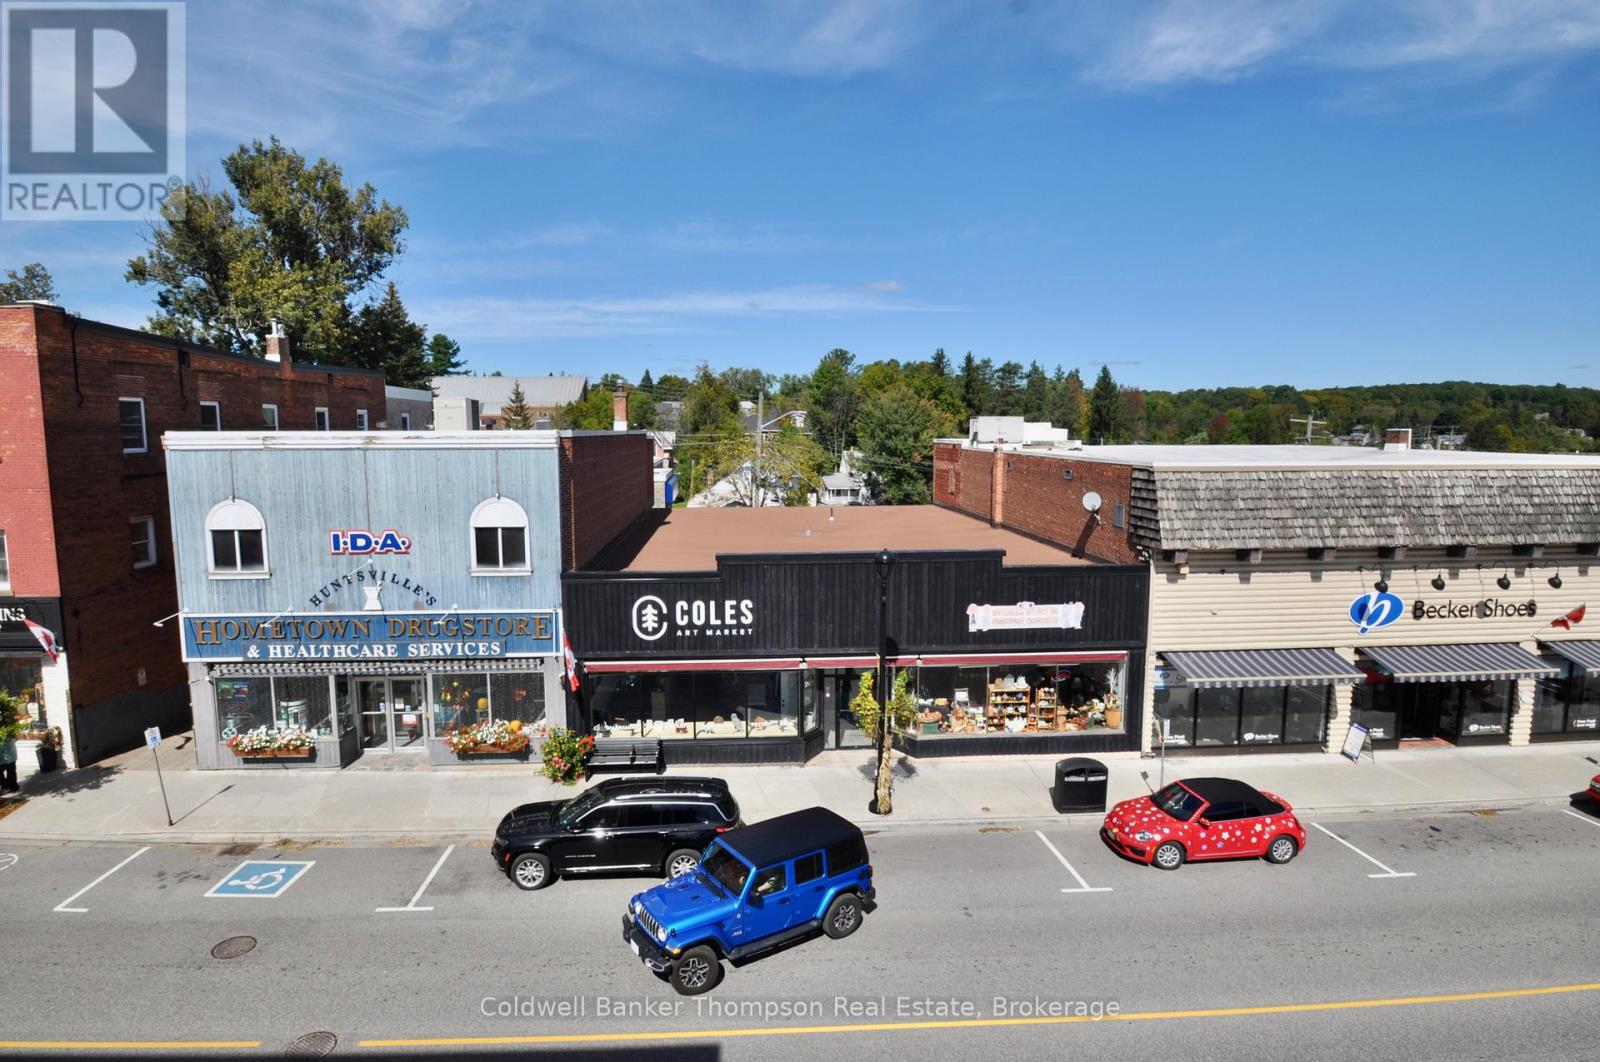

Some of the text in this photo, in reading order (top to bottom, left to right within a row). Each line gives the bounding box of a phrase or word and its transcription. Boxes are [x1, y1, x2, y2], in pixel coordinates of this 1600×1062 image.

[309, 569, 437, 607] HUNTSVILLE'S
[675, 599, 753, 626] COLES
[1413, 598, 1536, 619] Becker Shoes
[193, 614, 553, 646] HOMETOWN DRUGSTORE
[676, 628, 753, 637] ART MARKET
[246, 641, 501, 659] & HEALTHCARE SERVICES
